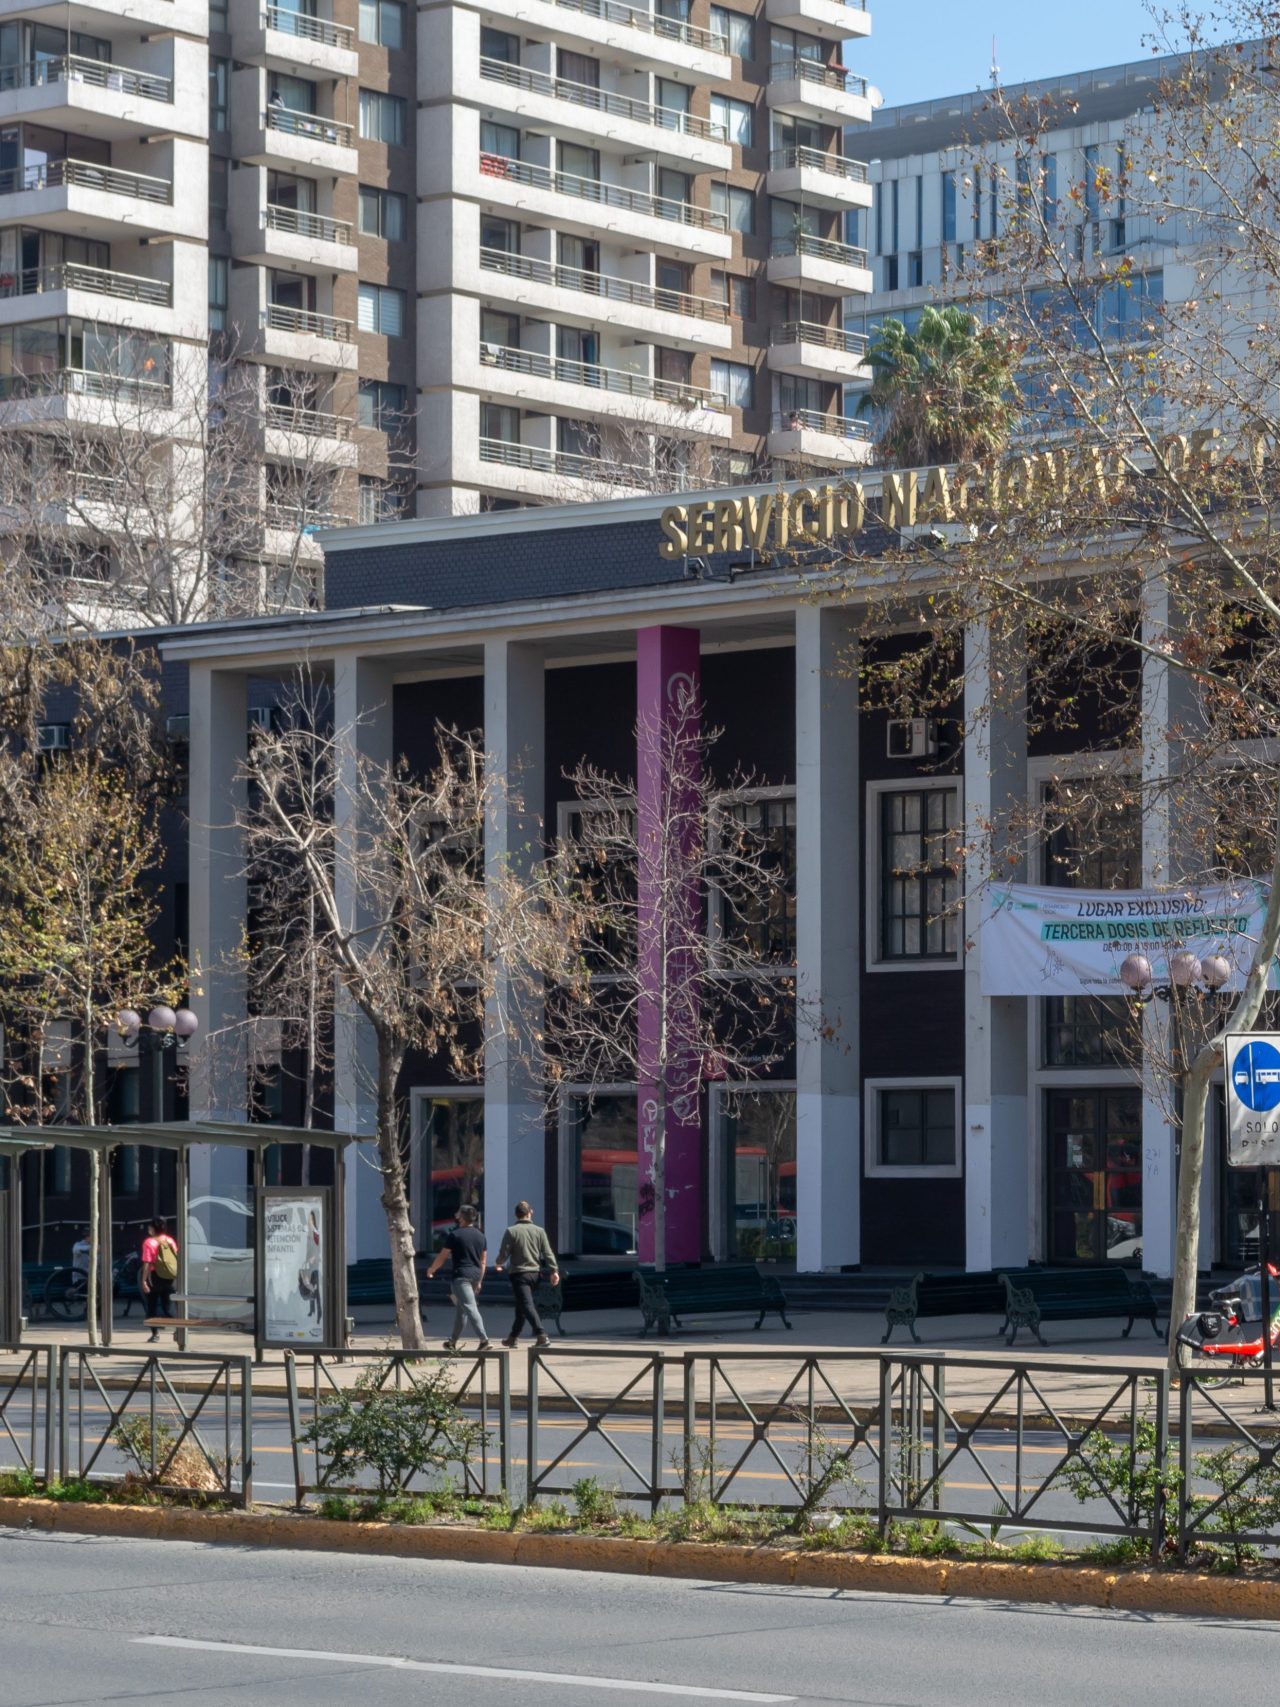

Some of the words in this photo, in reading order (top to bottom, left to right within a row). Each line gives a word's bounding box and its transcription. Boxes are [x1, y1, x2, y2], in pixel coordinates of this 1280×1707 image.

[659, 480, 865, 560] SERVICIO
[1077, 901, 1124, 917] LUGAR
[1045, 923, 1104, 940] TERCERA
[1107, 922, 1149, 939] DOSIS
[1152, 921, 1171, 938] DE
